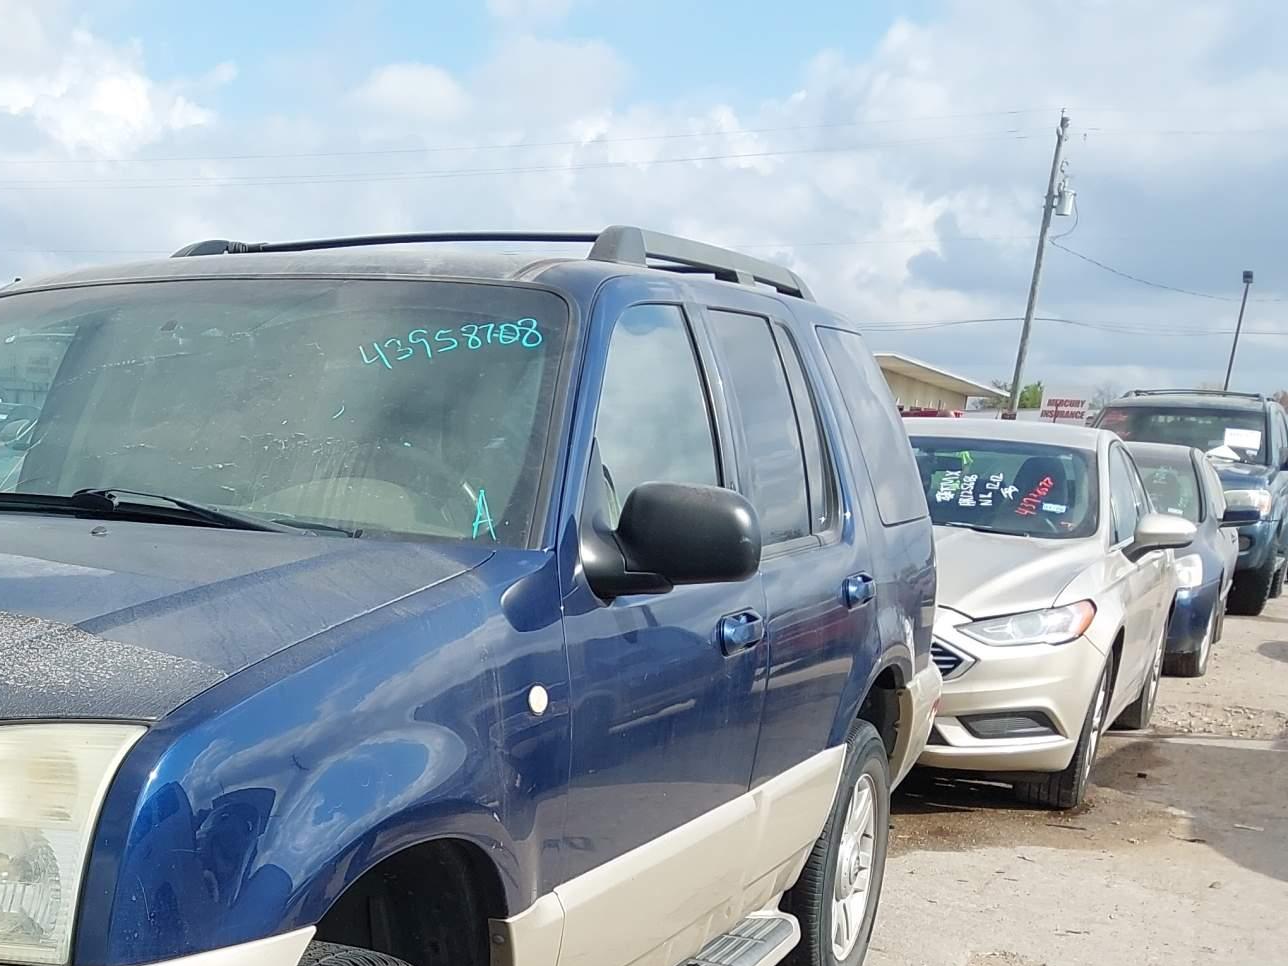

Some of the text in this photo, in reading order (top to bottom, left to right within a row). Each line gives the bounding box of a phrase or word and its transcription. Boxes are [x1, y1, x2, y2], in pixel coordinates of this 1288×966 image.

[1047, 399, 1086, 408] MERCURY
[1040, 410, 1085, 420] INSURANCE
[473, 490, 496, 540] A
